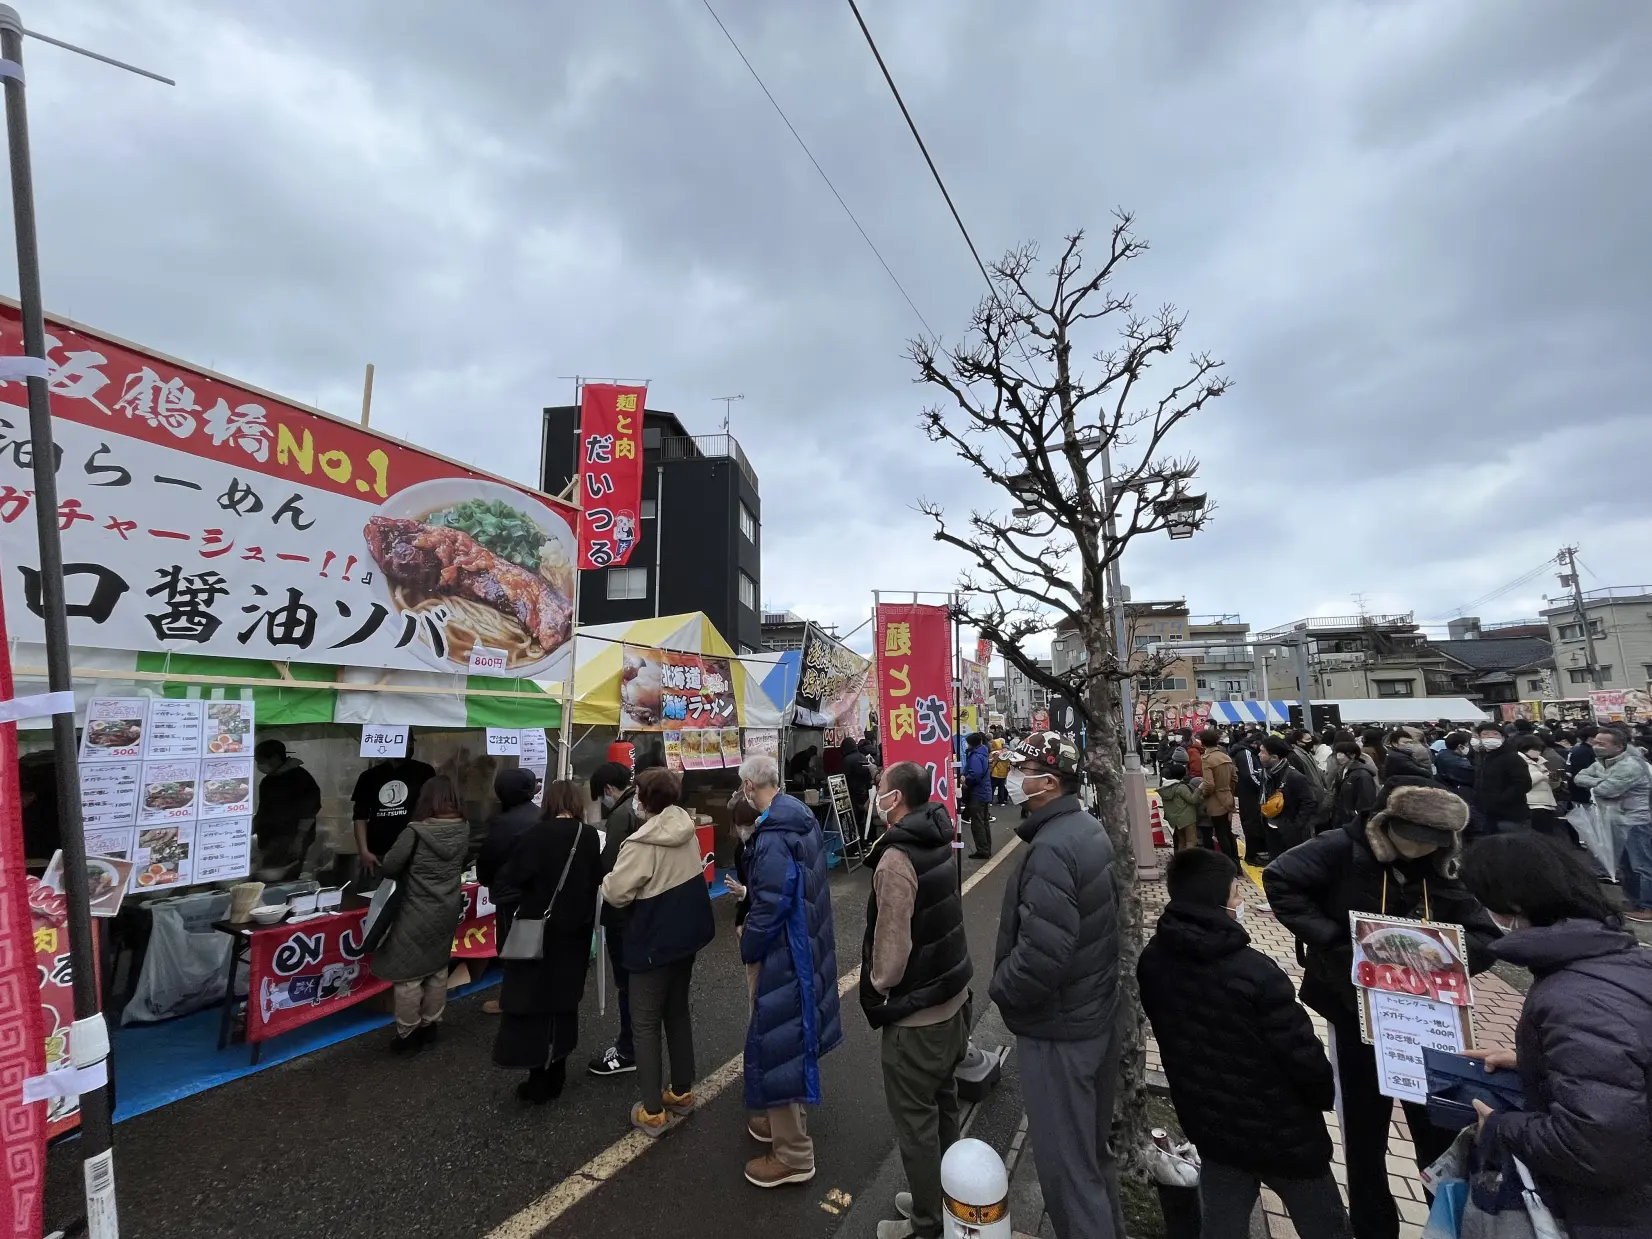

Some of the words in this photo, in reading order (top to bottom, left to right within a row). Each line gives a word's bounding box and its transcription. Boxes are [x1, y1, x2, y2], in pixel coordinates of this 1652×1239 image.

[615, 394, 638, 460] 麺と肉
[586, 434, 614, 566] だいつる
[474, 656, 503, 669] 800円
[661, 664, 701, 690] 北海道
[365, 733, 403, 745] お渡し口
[489, 735, 518, 745] ご注文口
